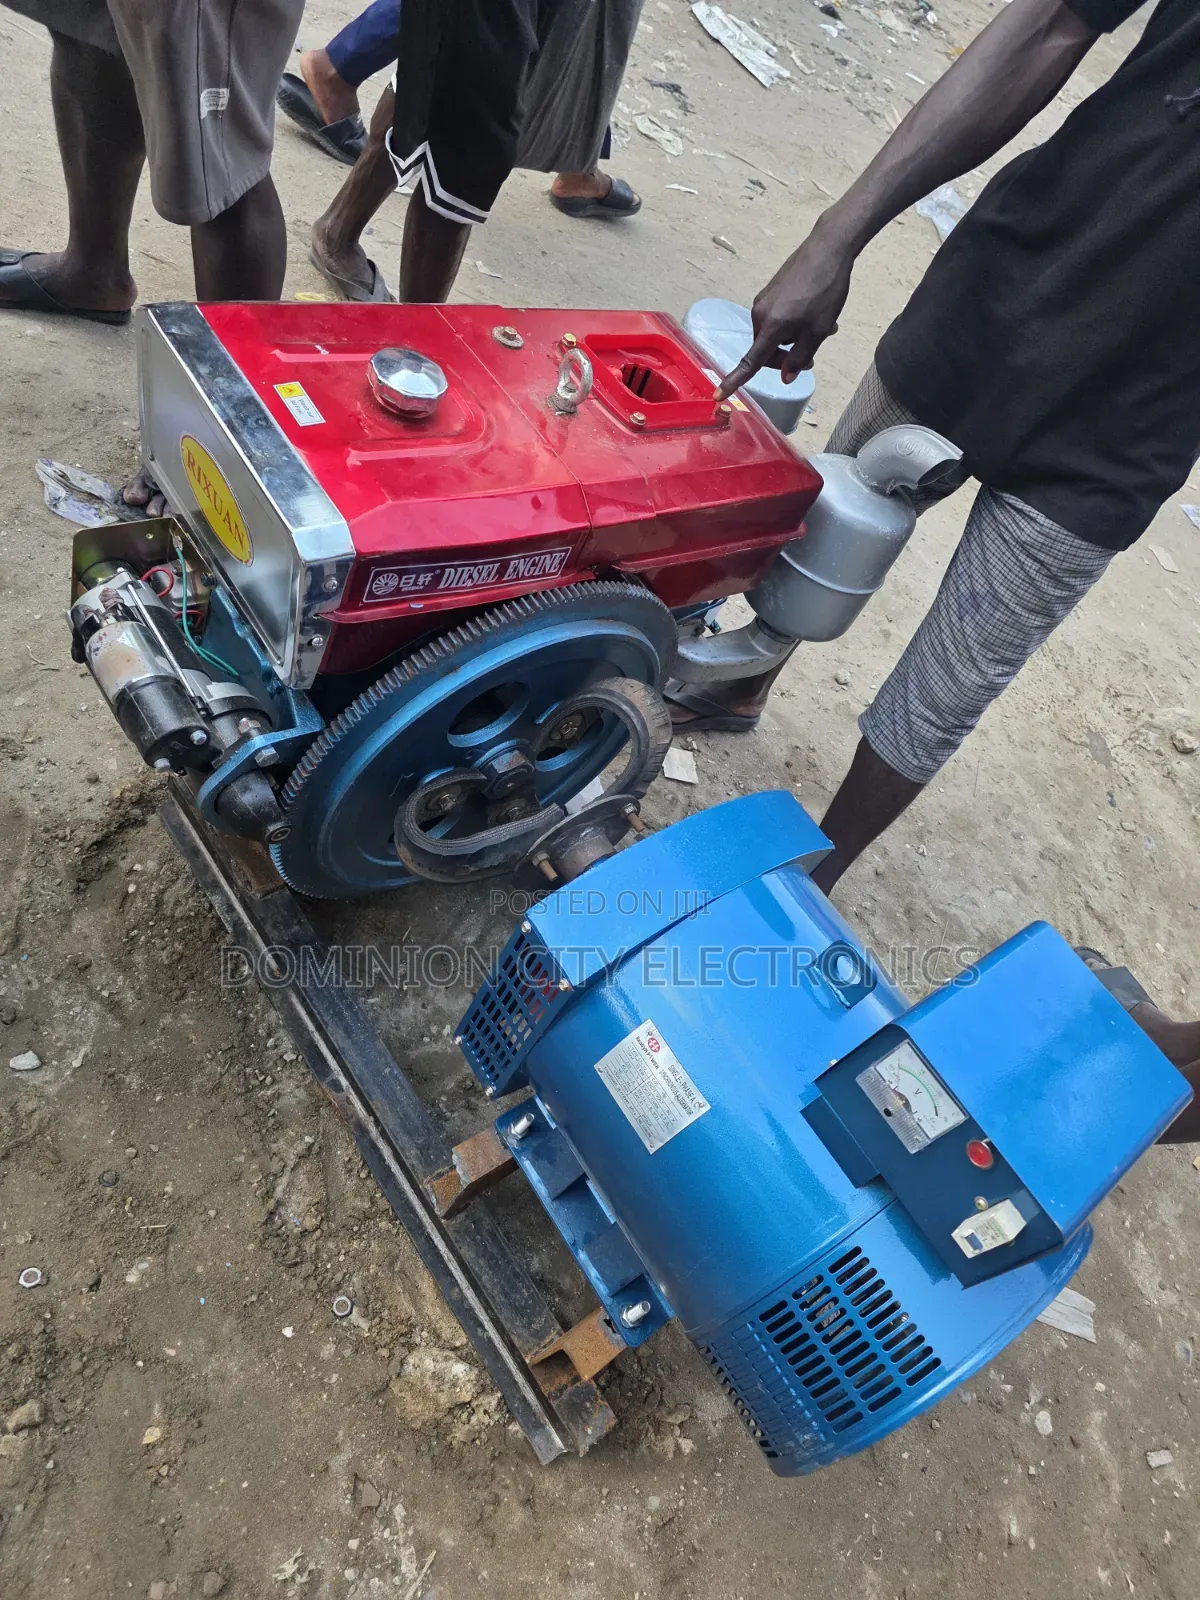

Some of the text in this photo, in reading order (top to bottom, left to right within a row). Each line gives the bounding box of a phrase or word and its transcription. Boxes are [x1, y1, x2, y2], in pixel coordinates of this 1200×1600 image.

[186, 447, 244, 552] RIXUAN
[437, 552, 566, 589] DIESEL ENGINE
